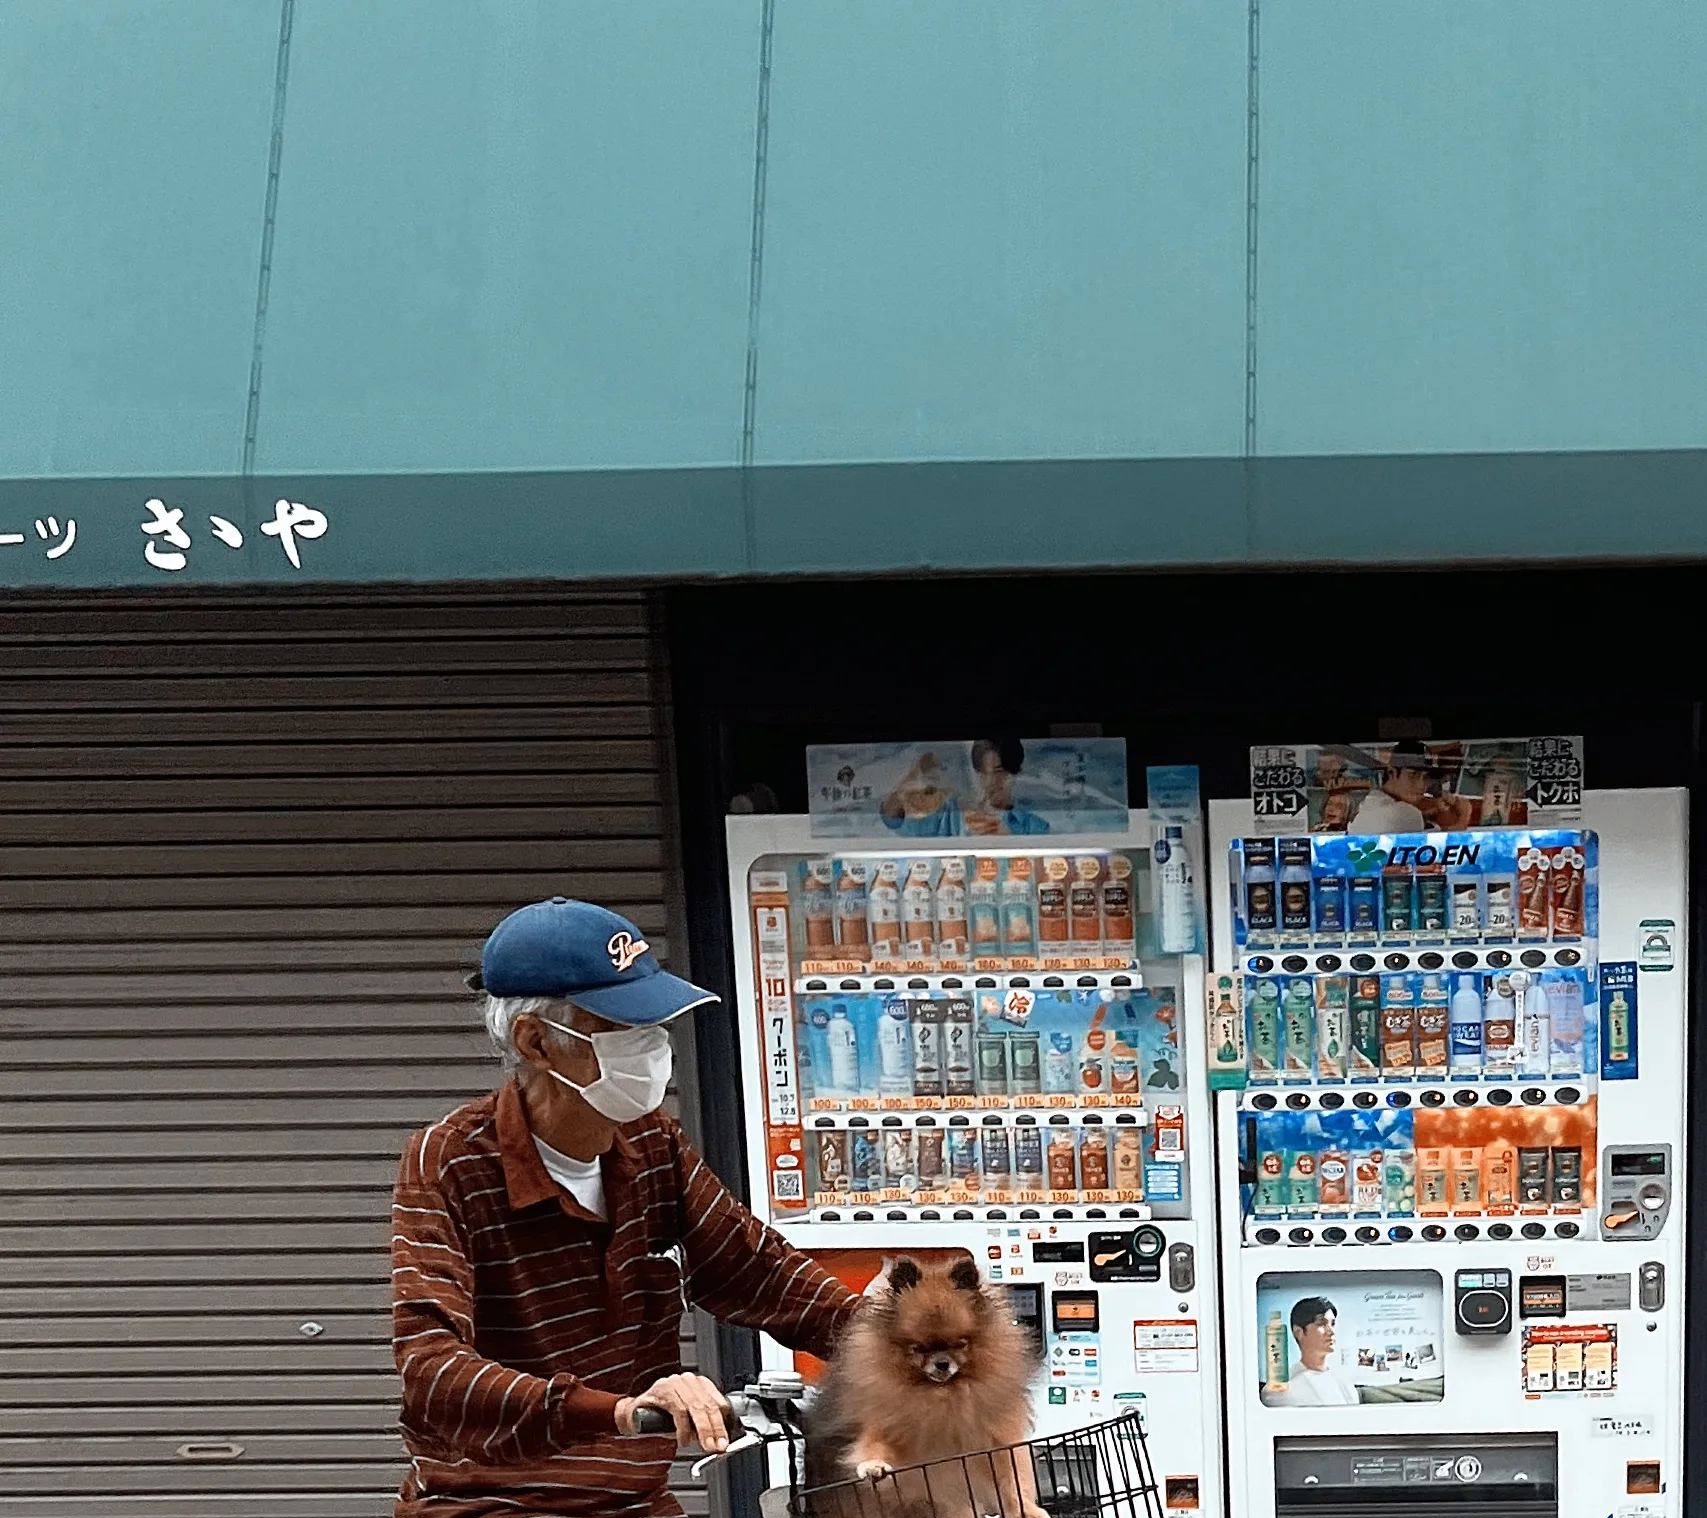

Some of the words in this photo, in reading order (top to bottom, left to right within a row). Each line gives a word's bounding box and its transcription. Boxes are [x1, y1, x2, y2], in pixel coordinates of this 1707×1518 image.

[1254, 767, 1305, 787] こだわる
[1529, 758, 1580, 778] こだわる
[1537, 782, 1580, 804] トクホ
[1256, 792, 1297, 814] オトコ
[1388, 845, 1438, 867] ITO
[1441, 844, 1481, 866] EN
[1459, 915, 1472, 926] 20
[1493, 914, 1506, 925] 20
[766, 978, 785, 997] 10
[1530, 1020, 1541, 1052] evian
[773, 1017, 789, 1087] クーポン
[1115, 1097, 1132, 1106] 140
[1051, 1191, 1069, 1201] 130
[1086, 1191, 1103, 1201] 130
[1116, 1190, 1134, 1200] 130
